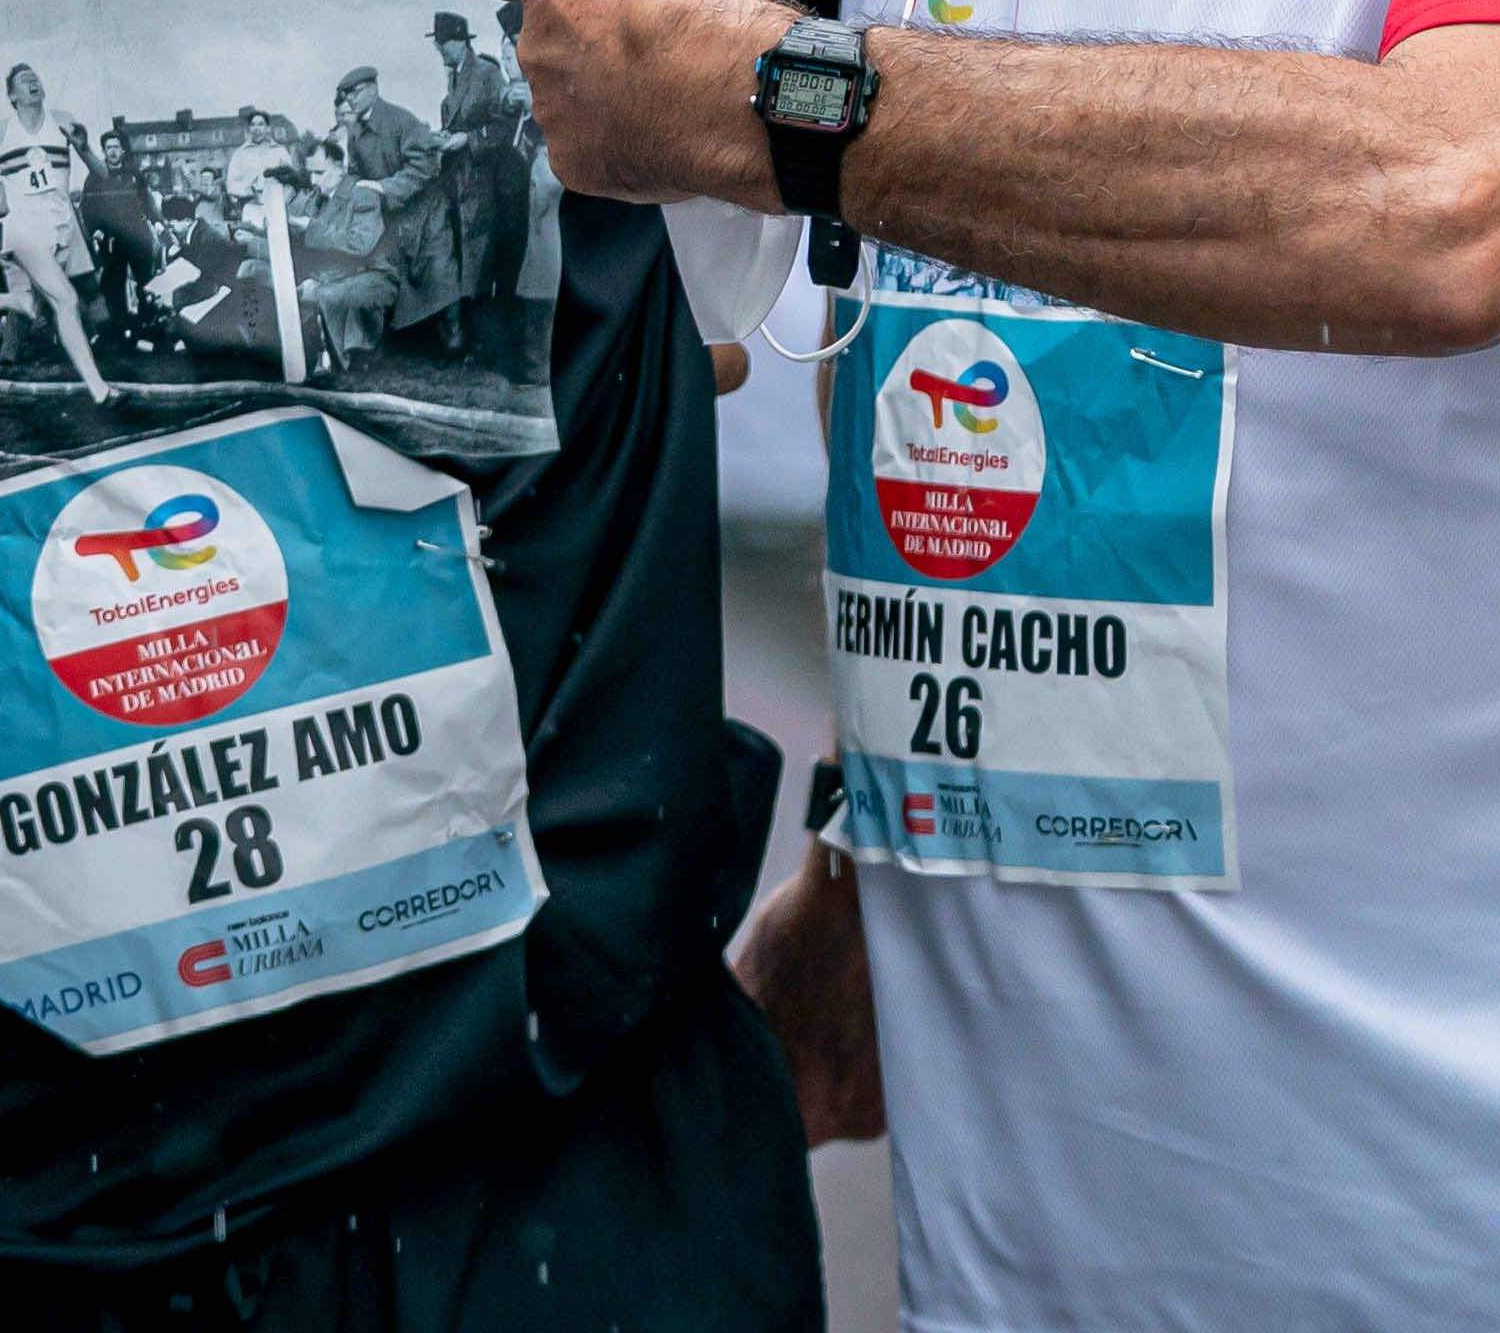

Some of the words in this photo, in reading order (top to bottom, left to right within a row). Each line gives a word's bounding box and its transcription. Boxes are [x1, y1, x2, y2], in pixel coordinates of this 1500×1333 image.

[30, 169, 48, 188] 41
[906, 443, 1009, 472] TotalEnergies
[925, 491, 974, 513] MILLA
[904, 535, 925, 553] DE
[927, 537, 992, 560] MADRID
[89, 578, 240, 625] TotalEnergies
[136, 629, 209, 662] MILLA
[961, 605, 1128, 679] CACHO
[121, 691, 155, 713] DE
[157, 667, 247, 704] MADRID
[909, 672, 984, 760] 26
[0, 728, 280, 856] GONZÁLEZ
[294, 693, 424, 783] AMO
[175, 803, 285, 906] 28
[232, 919, 314, 953] MILLA
[237, 937, 325, 979] URBANA
[19, 971, 143, 1021] MADRID
